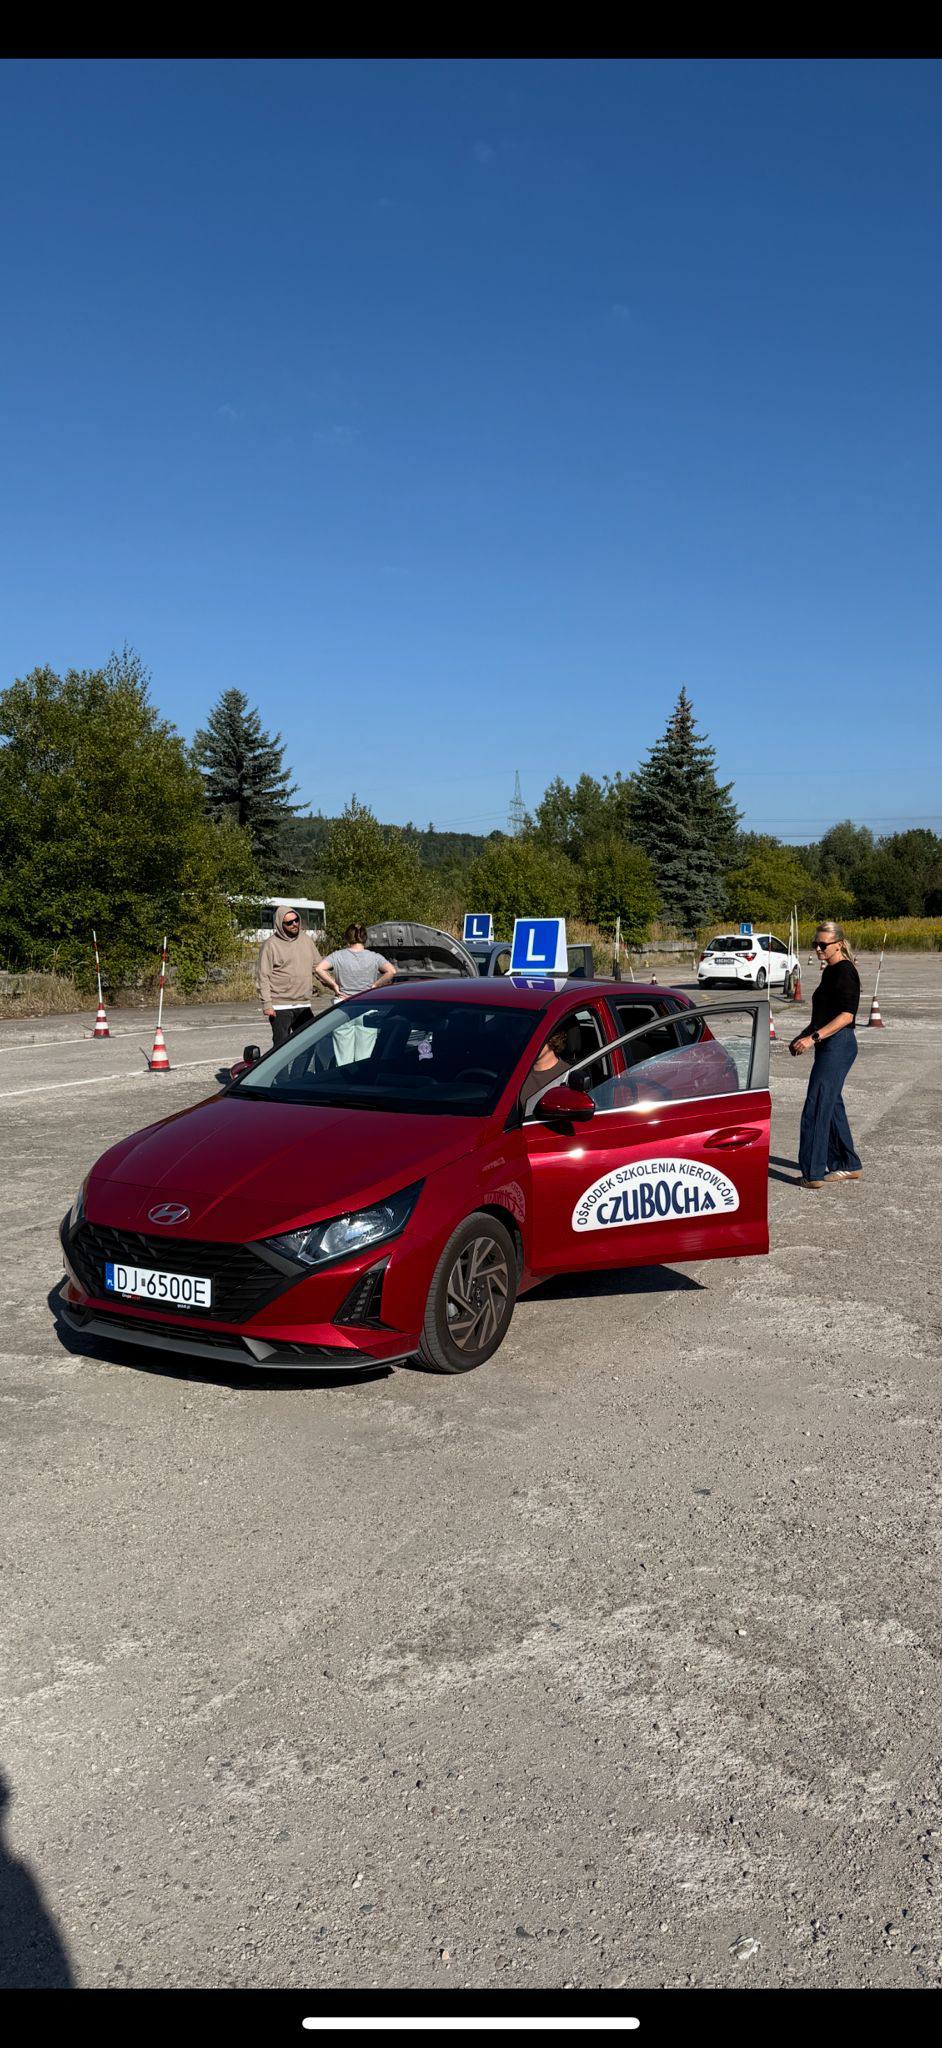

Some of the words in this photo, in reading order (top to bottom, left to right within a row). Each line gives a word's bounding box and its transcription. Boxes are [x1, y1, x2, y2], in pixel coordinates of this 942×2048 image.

[473, 918, 483, 935] L
[743, 925, 749, 933] L
[526, 928, 546, 961] L
[577, 1178, 616, 1225] OŚRODEK
[615, 1162, 676, 1184] SZKOLENIA
[679, 1163, 735, 1206] KIEROWCÓW
[596, 1180, 717, 1225] CZUBOCHA
[117, 1267, 137, 1292] DJ
[147, 1273, 206, 1304] 6500E
